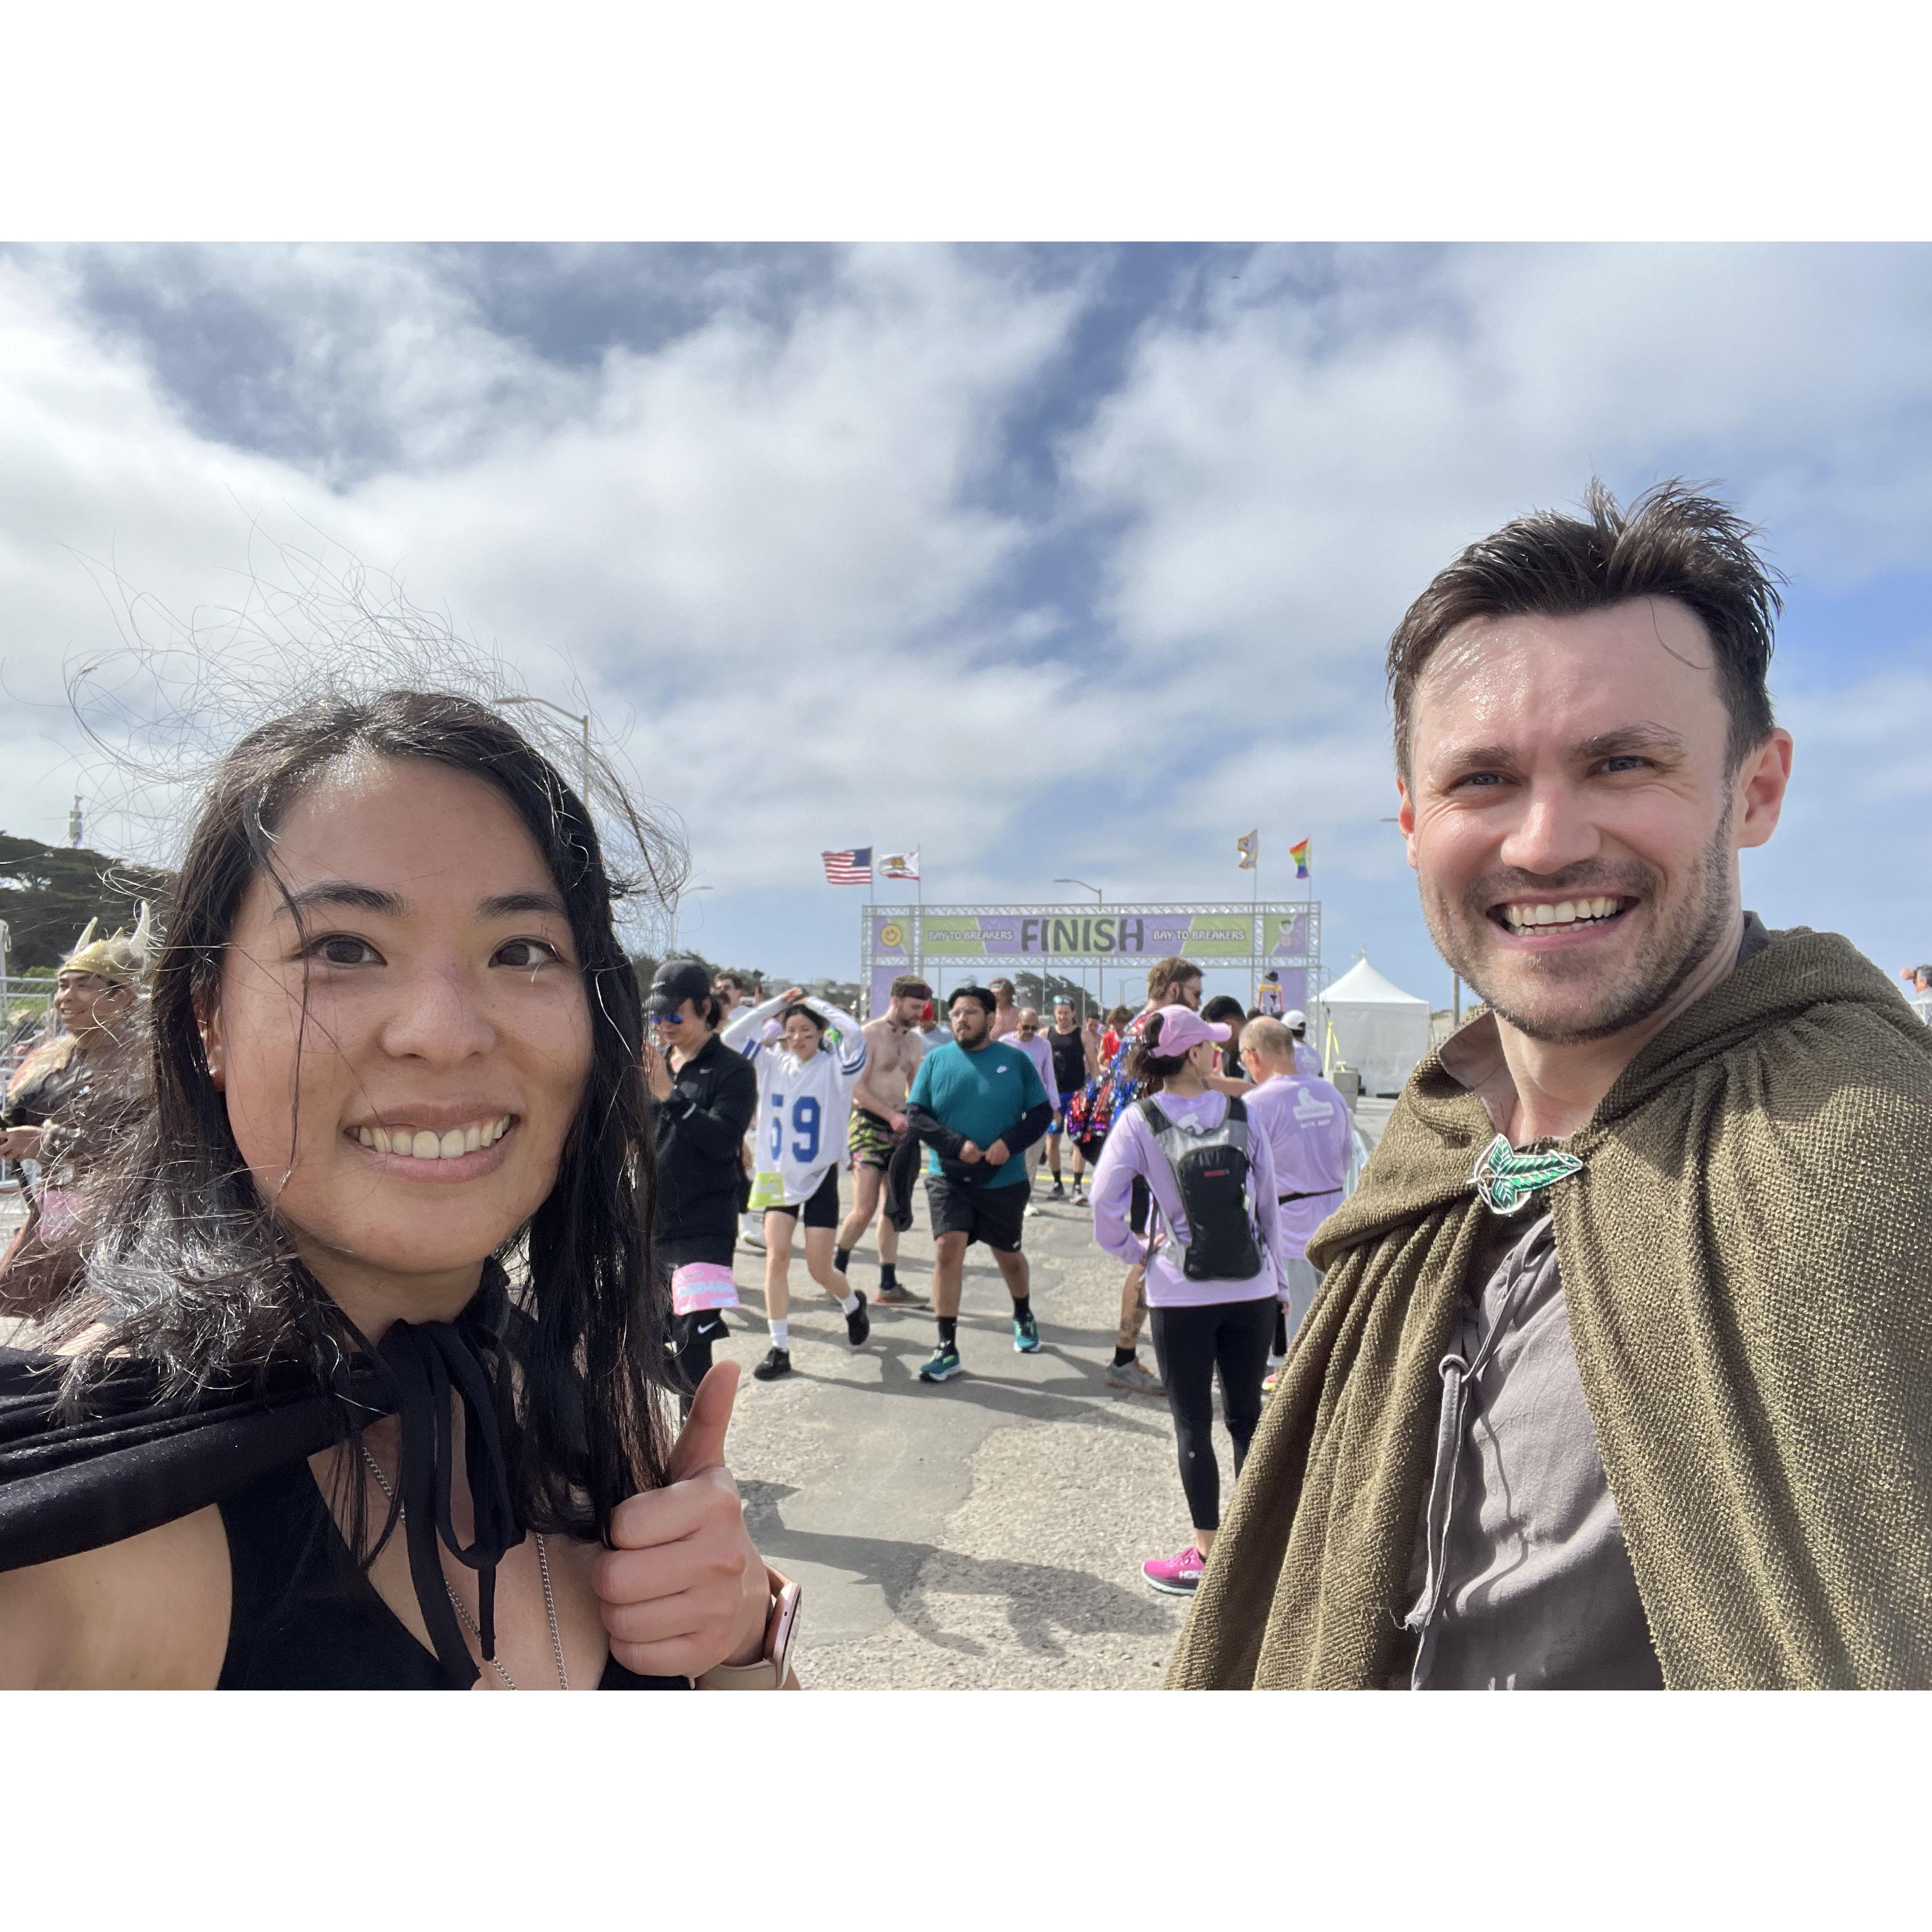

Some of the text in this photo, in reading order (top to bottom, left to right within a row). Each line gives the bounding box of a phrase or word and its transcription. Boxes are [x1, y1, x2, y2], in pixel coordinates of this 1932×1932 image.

[928, 931, 1013, 940] BAY TO BREAKERS
[1021, 919, 1144, 952] FINISH
[1153, 930, 1245, 940] BAY TO BREAKERS
